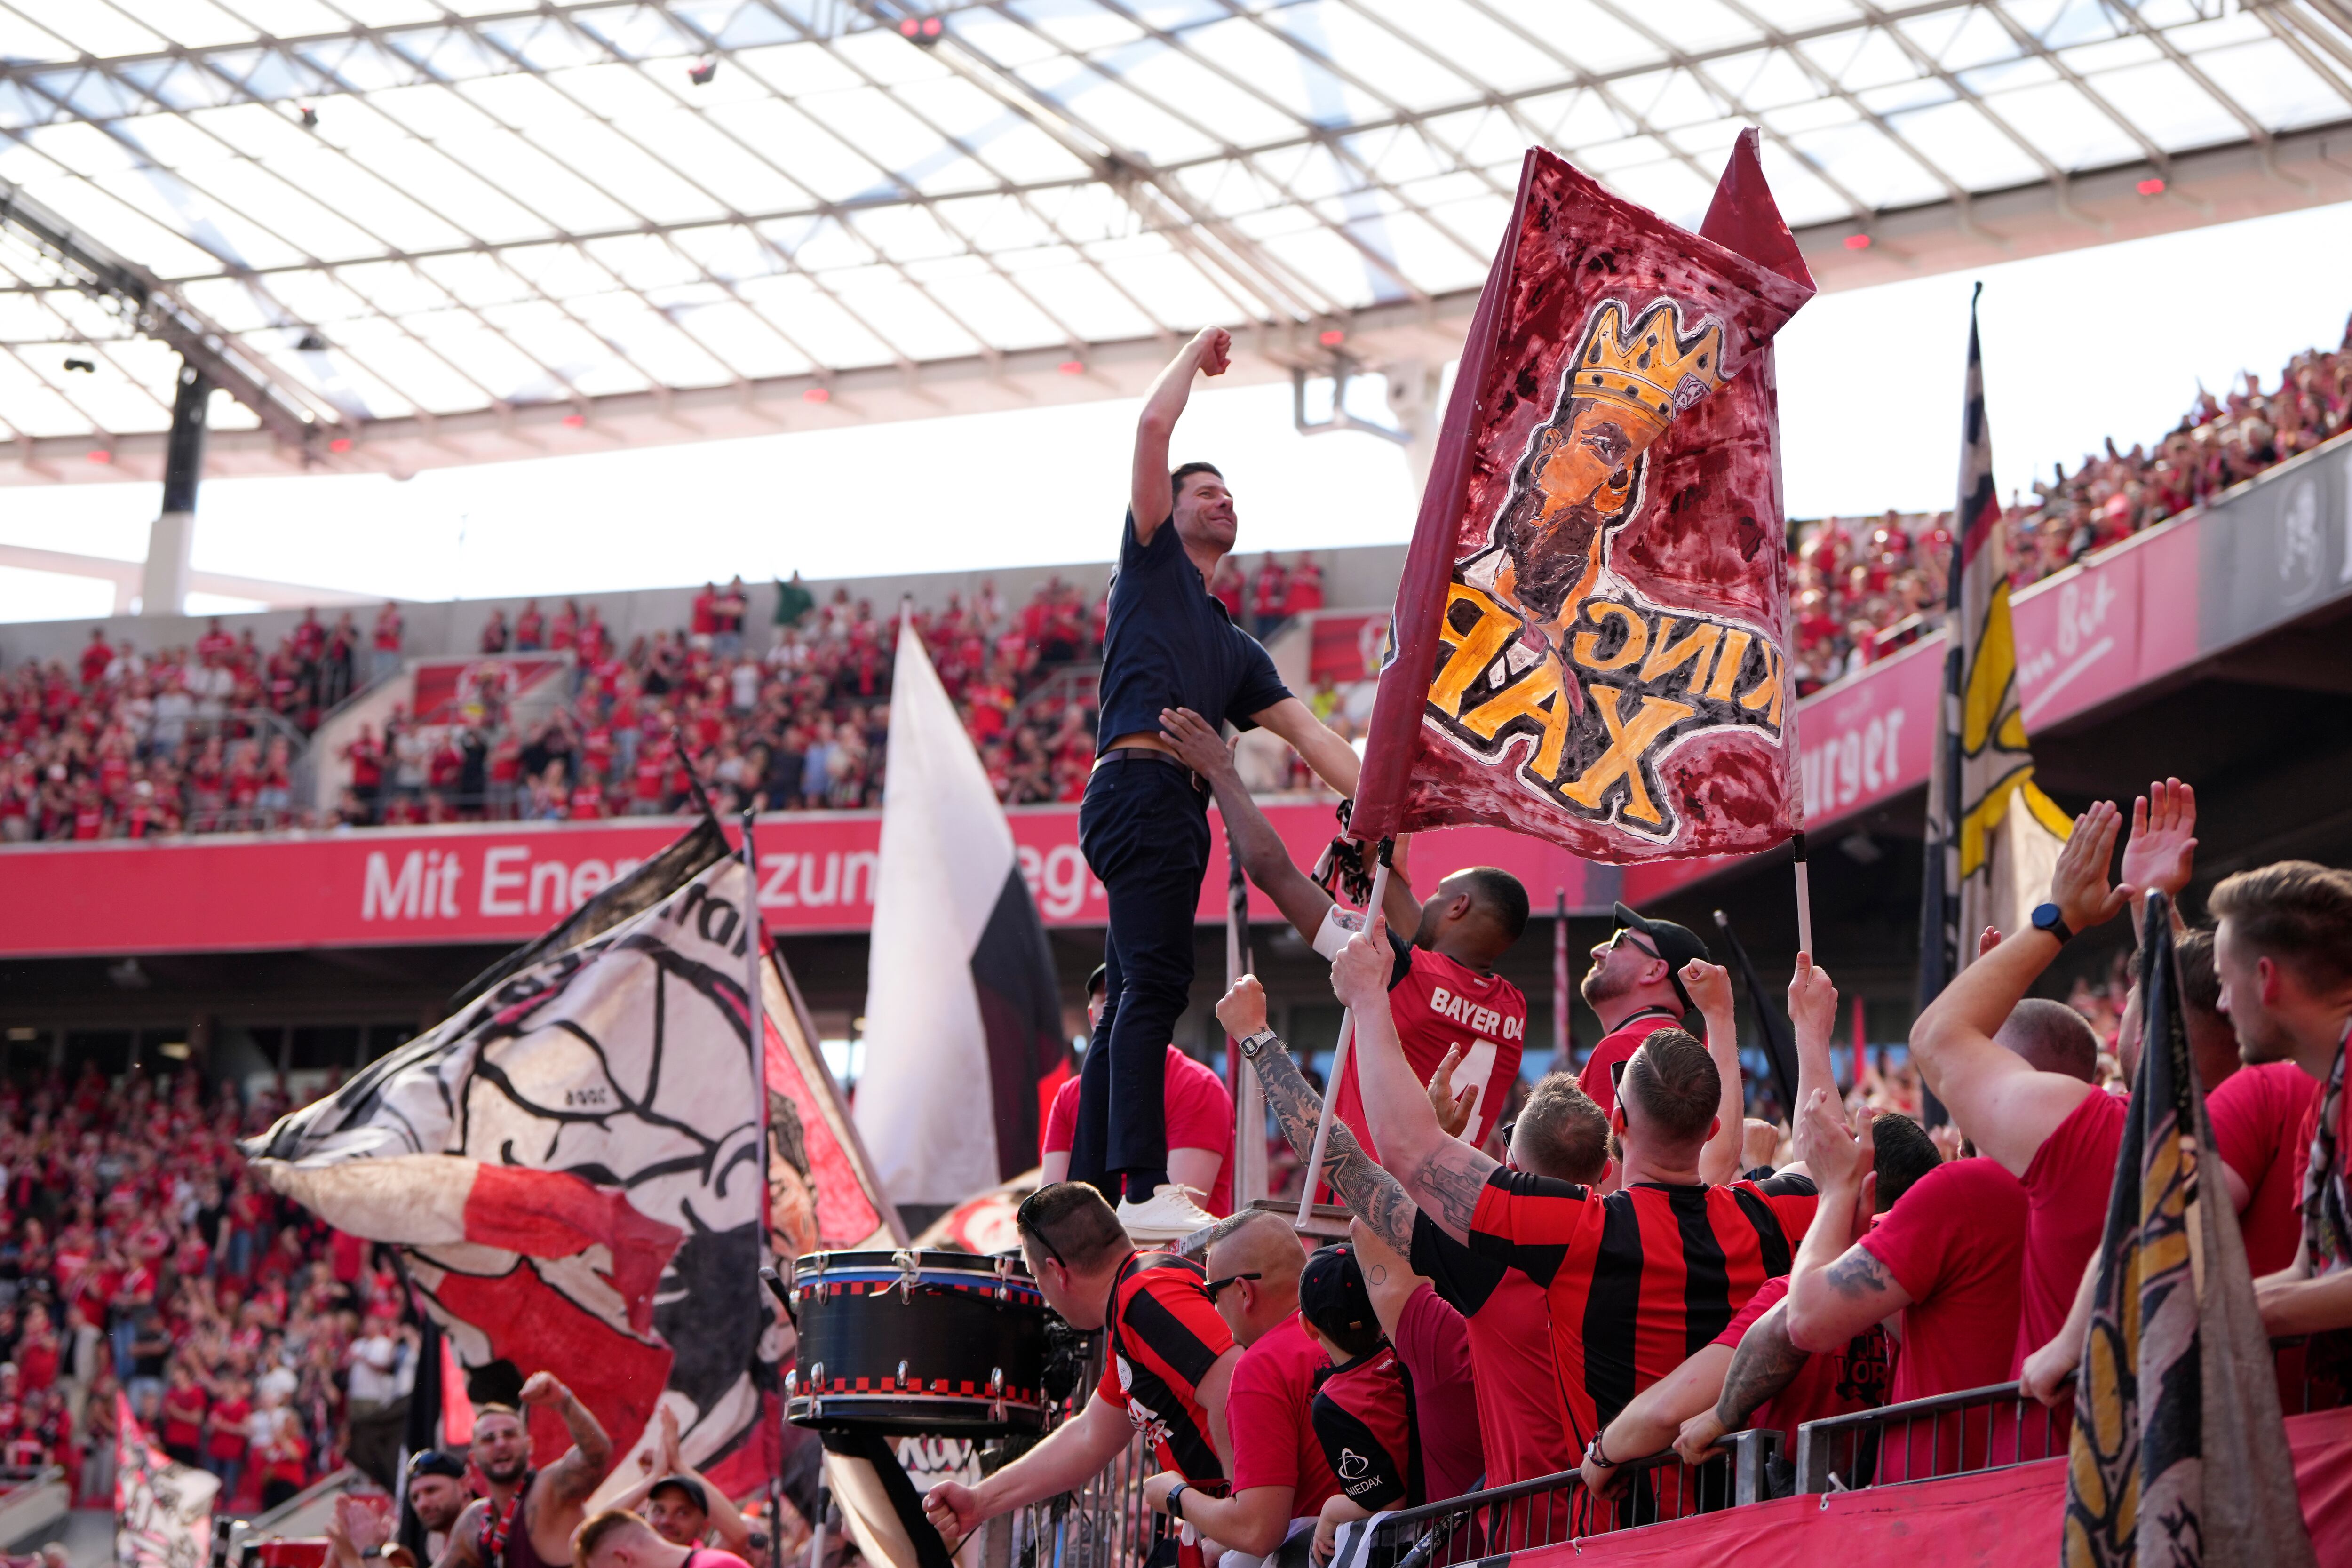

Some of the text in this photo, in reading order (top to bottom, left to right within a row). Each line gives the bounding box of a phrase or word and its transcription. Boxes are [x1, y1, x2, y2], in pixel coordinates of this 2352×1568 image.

[361, 849, 462, 920] Mit
[1430, 987, 1524, 1041] BAYER 04
[1449, 1037, 1498, 1145] 4
[1345, 1475, 1383, 1496] NIEDAX
